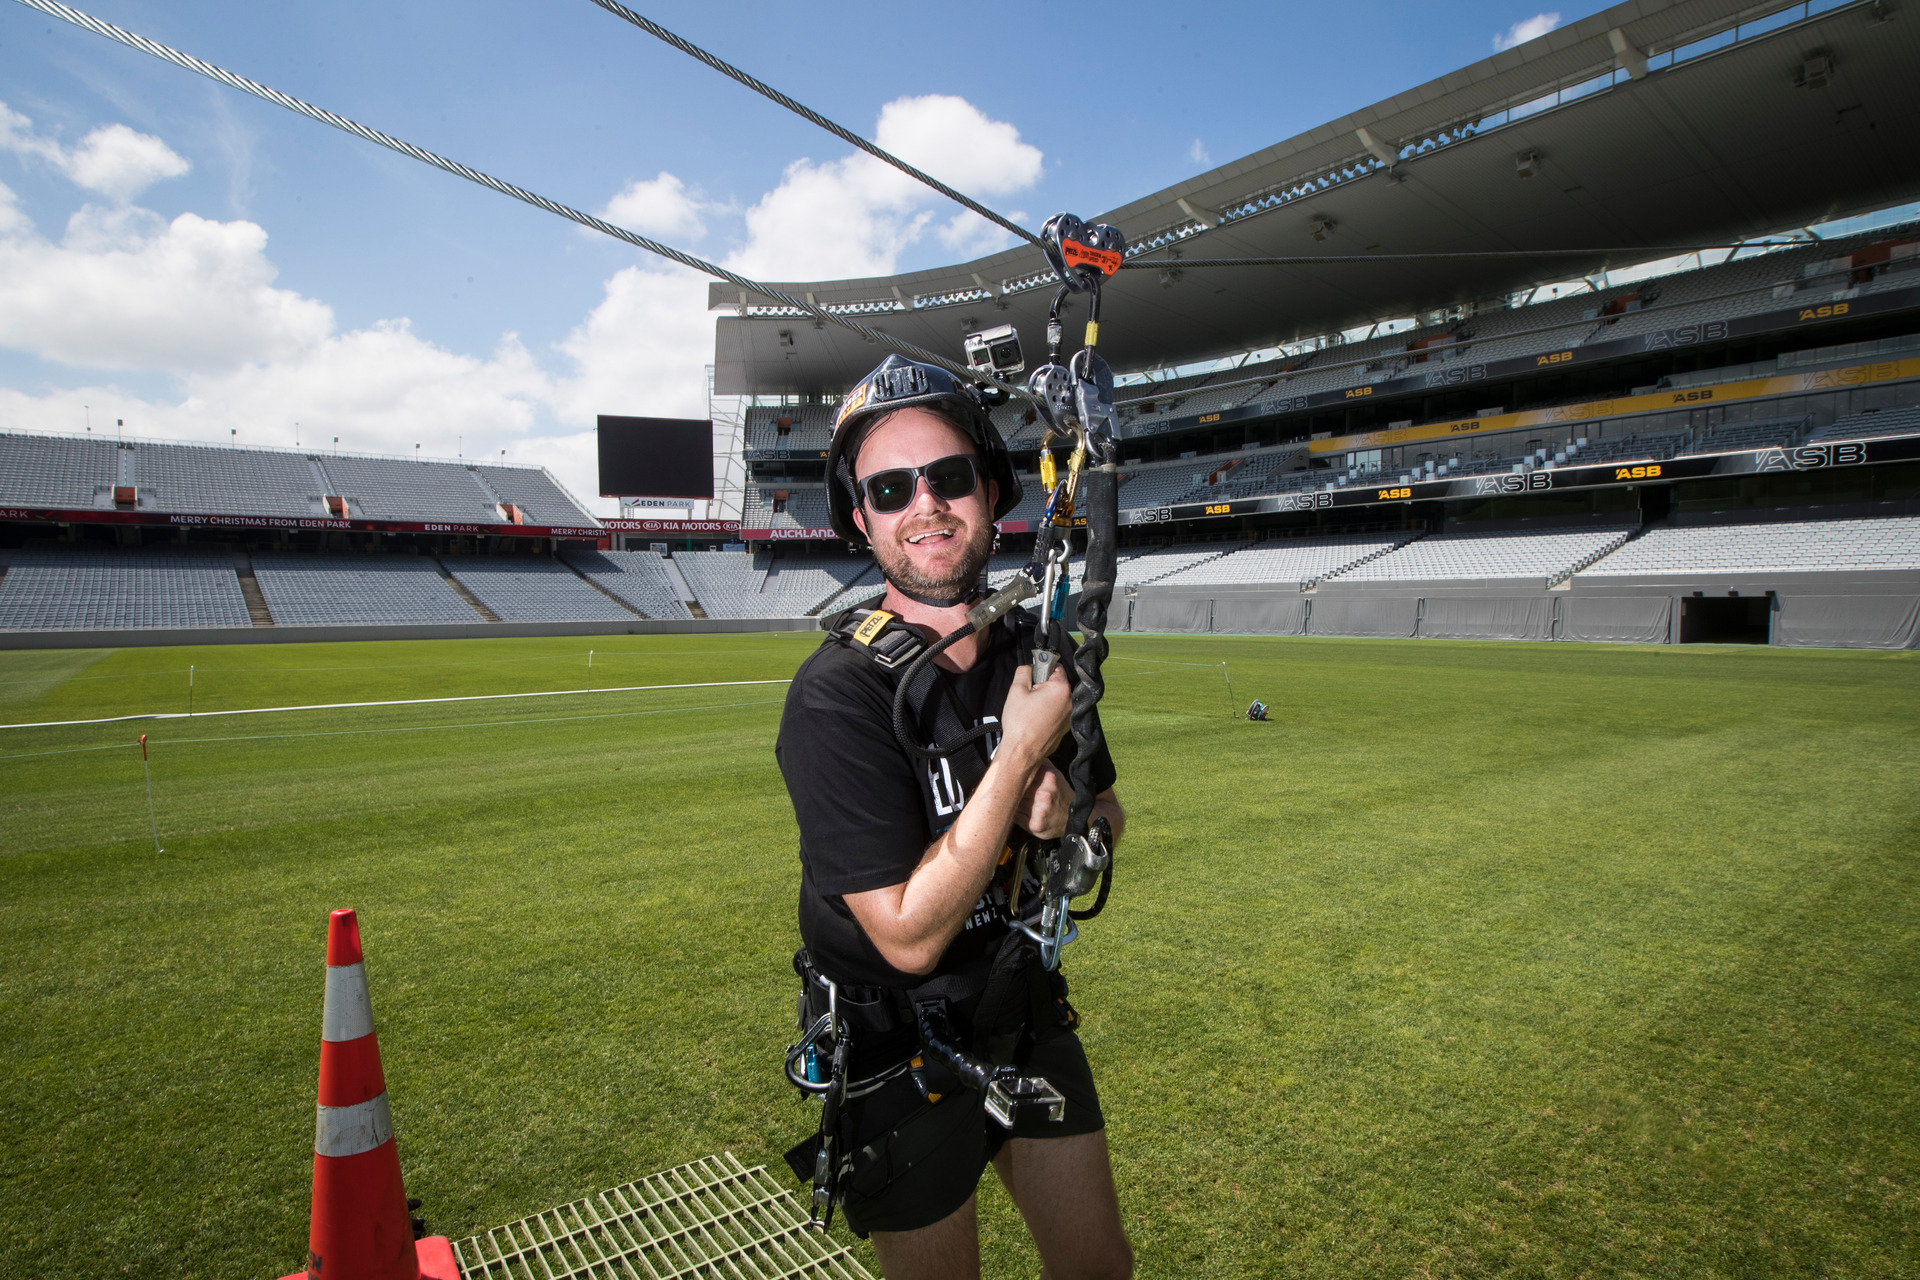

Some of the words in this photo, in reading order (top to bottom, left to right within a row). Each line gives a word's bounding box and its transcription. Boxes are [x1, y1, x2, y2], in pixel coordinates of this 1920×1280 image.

[1800, 303, 1849, 321] ASB
[1644, 320, 1728, 351] ASB
[1537, 351, 1573, 366] ASB
[1425, 364, 1487, 388] ASB
[1803, 361, 1900, 391] ASB
[1346, 387, 1373, 398] ASB
[1673, 390, 1713, 403] ASB
[1261, 395, 1308, 415] ASB
[1545, 400, 1615, 423] ASB
[1199, 413, 1221, 423] ASB
[1132, 420, 1170, 437] ASB
[1450, 421, 1480, 432] ASB
[1355, 429, 1408, 448] ASB
[748, 450, 791, 459] ASB
[1755, 442, 1867, 472] ASB
[1616, 465, 1662, 480] ASB
[1475, 472, 1553, 495] ASB
[1278, 492, 1334, 511] ASB
[1378, 488, 1412, 500] ASB
[1129, 507, 1173, 523] ASB
[1205, 504, 1230, 515] ASB
[170, 515, 208, 524] MERRY
[210, 516, 267, 526] CHRISTMAS
[269, 518, 298, 527] FROM
[299, 519, 325, 528] EDEN
[326, 520, 351, 529] PARK
[662, 522, 679, 530] KIA
[681, 522, 721, 530] MOTORS
[770, 529, 838, 538] AUCKLAND
[860, 615, 884, 637] PETZL
